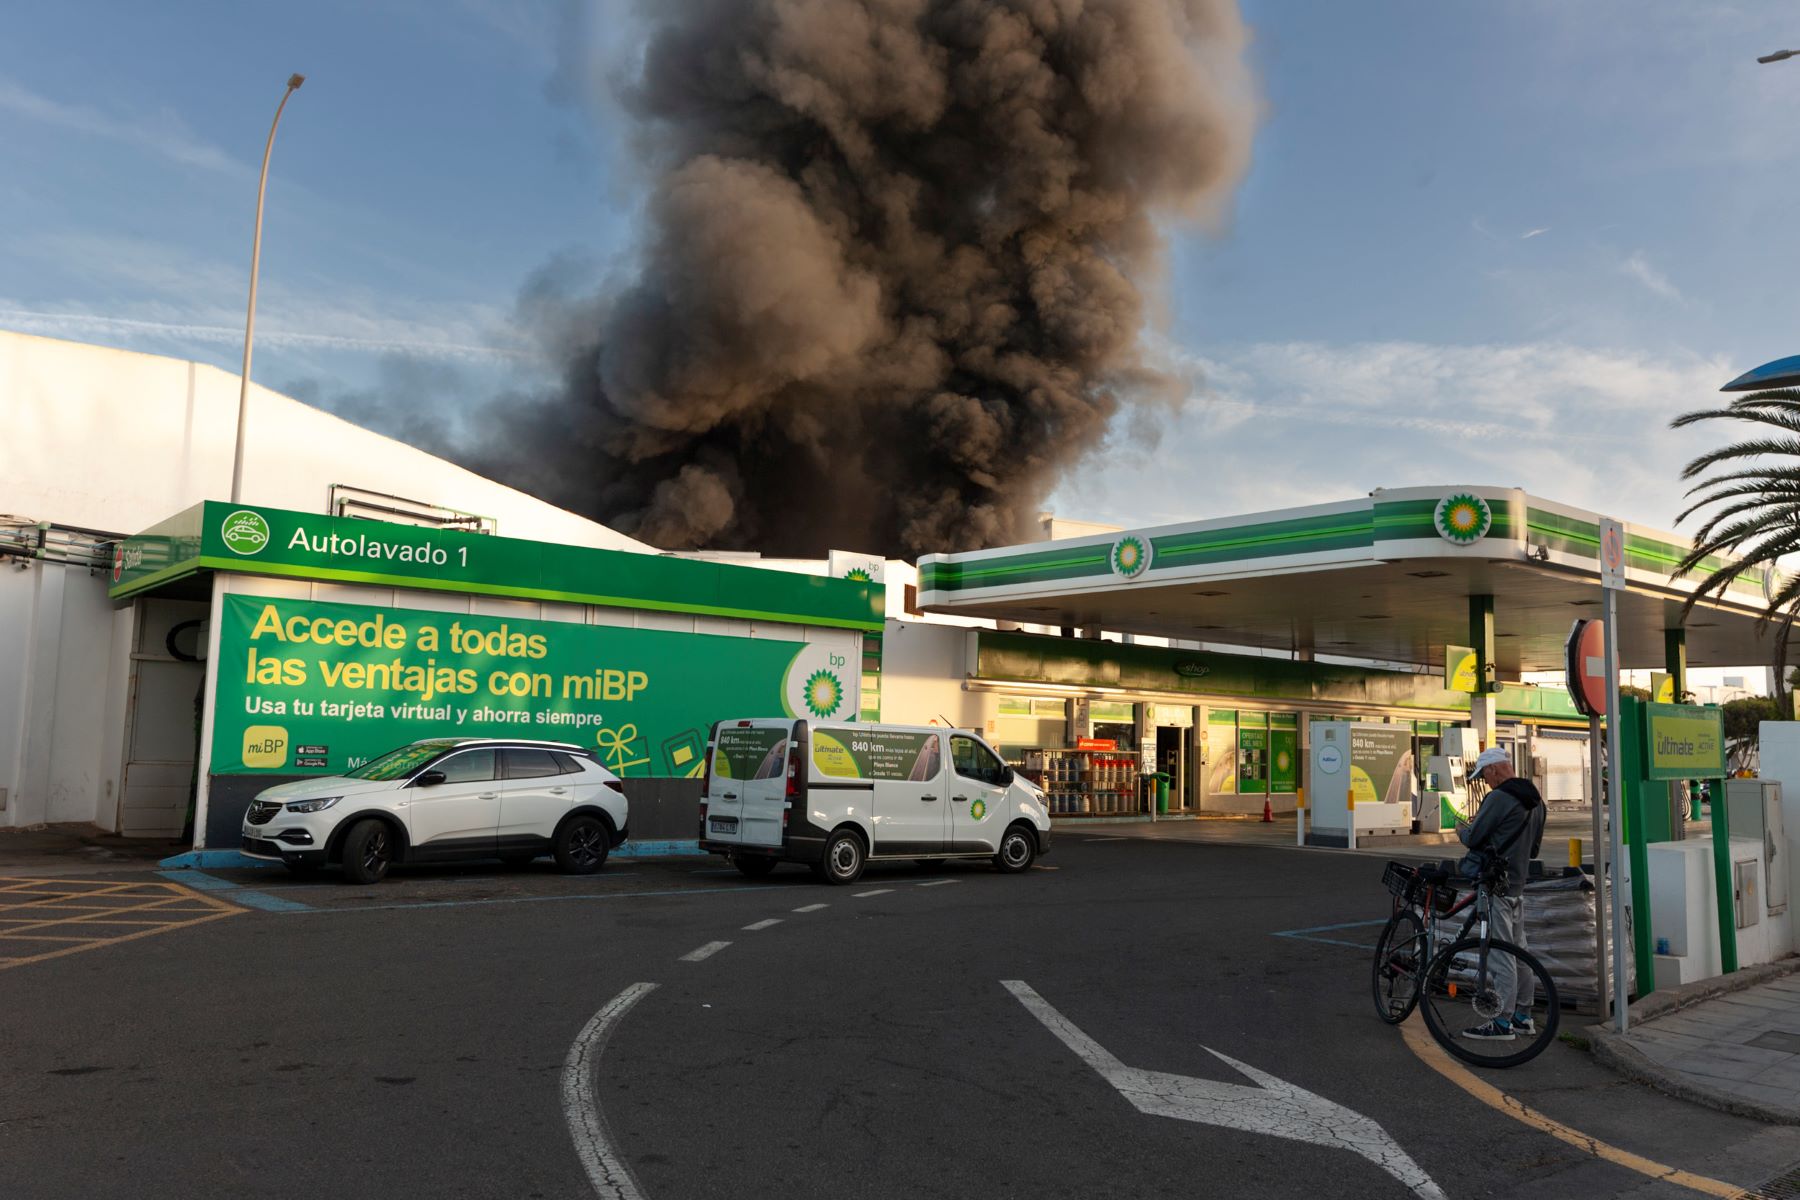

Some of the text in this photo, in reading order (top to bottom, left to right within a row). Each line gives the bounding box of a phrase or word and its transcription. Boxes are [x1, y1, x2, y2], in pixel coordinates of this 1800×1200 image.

[288, 527, 468, 567] Autolavado 1
[868, 561, 879, 573] bp
[250, 605, 548, 660] Accede a todas
[829, 652, 846, 670] bp
[246, 647, 649, 701] las ventajas con miBP
[245, 696, 603, 729] Usa tu tarjeta virtual y ahorra siempre
[1242, 732, 1264, 740] OFERTAS
[1352, 739, 1363, 748] 840
[1365, 739, 1375, 748] km
[248, 739, 284, 754] miBP
[852, 741, 868, 752] 840
[870, 742, 885, 753] km
[1657, 736, 1694, 755] ultimate
[347, 757, 370, 768] Má
